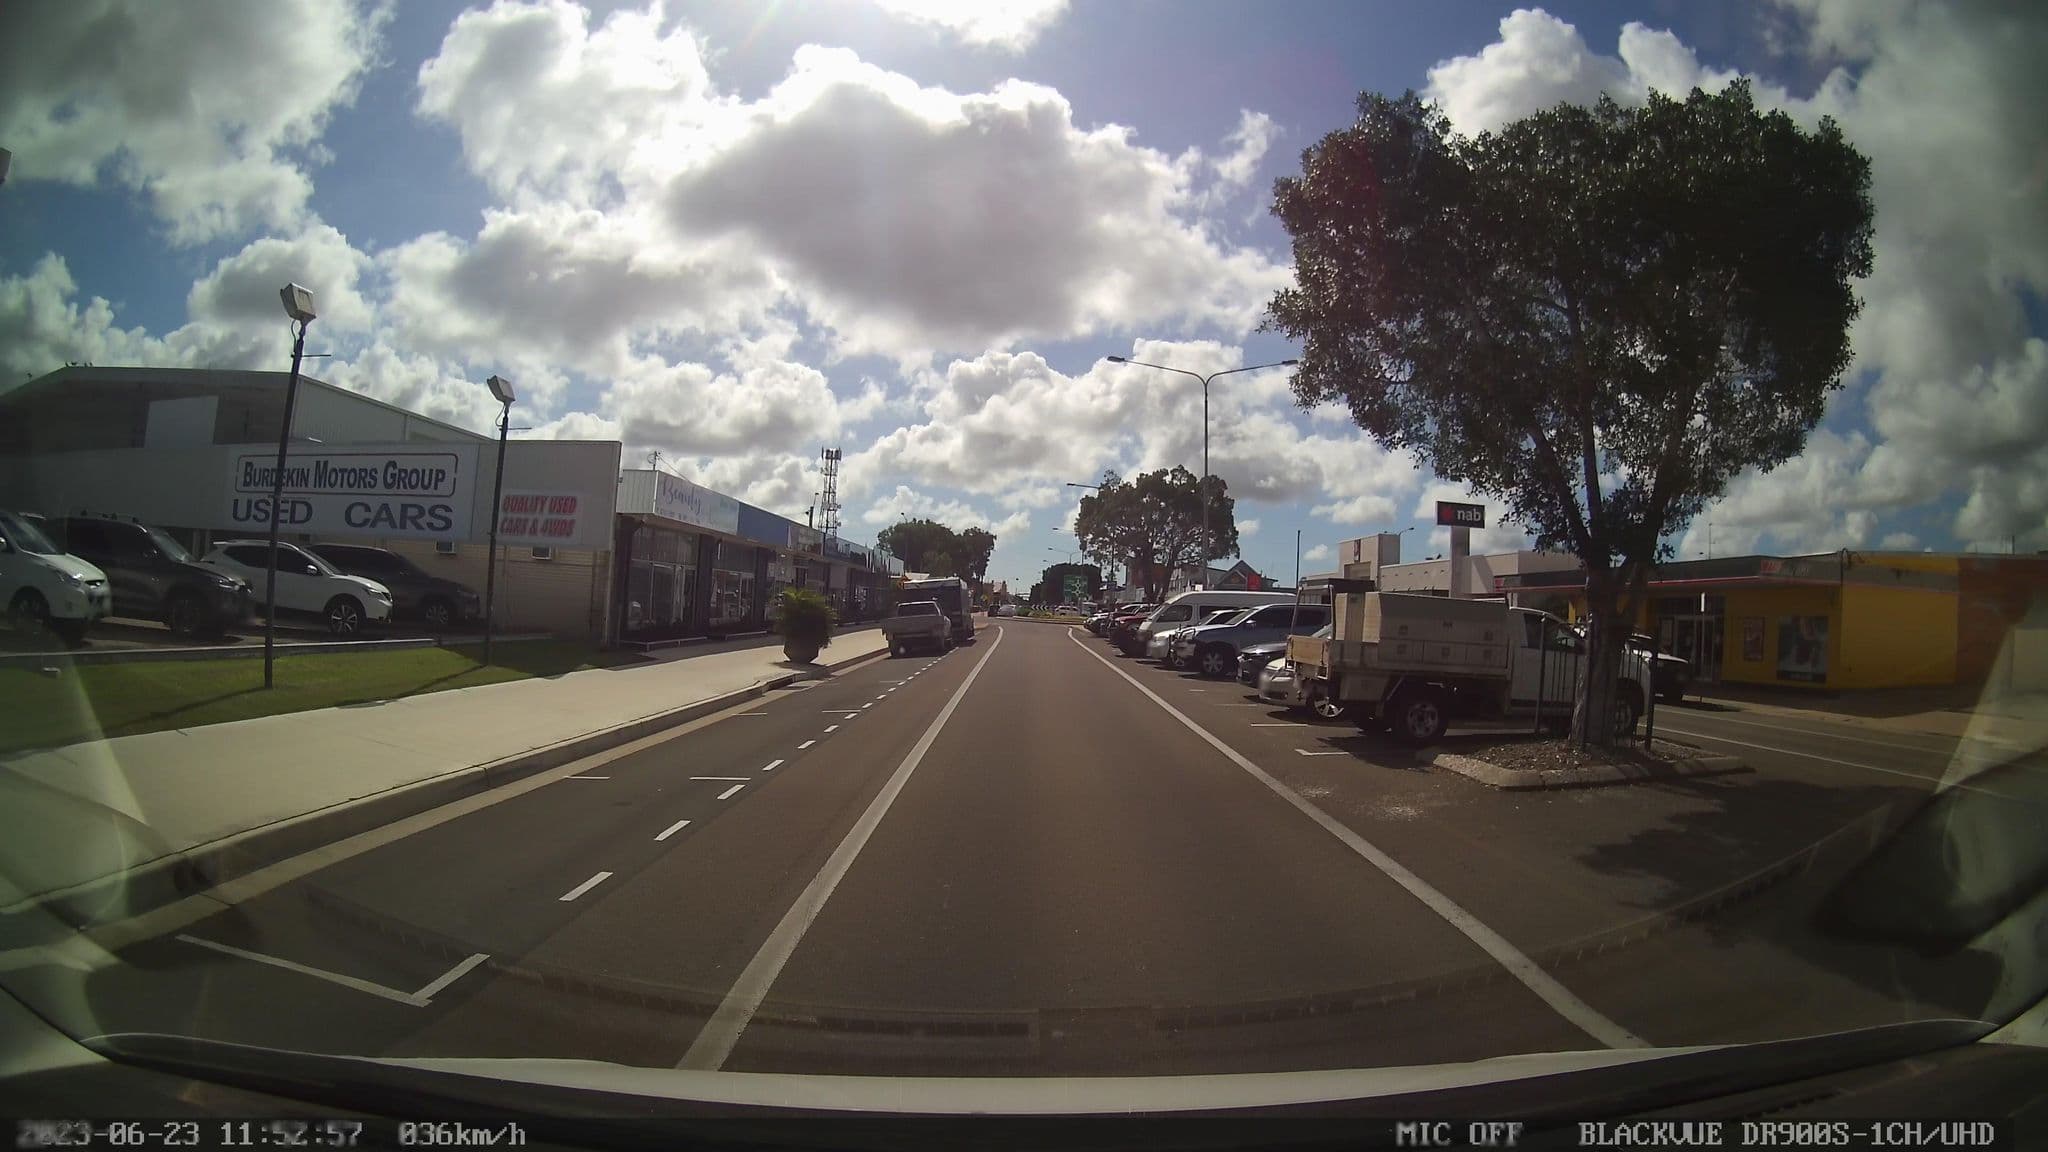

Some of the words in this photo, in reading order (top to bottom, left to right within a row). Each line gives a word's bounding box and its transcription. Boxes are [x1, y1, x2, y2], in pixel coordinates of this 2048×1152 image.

[313, 460, 378, 489] MOTORS
[383, 460, 446, 490] GROUP
[503, 494, 548, 514] QUALITY
[549, 495, 577, 515] USED
[1456, 508, 1481, 521] nab
[232, 499, 313, 524] USED
[344, 501, 453, 532] CARS
[500, 517, 528, 536] CARS
